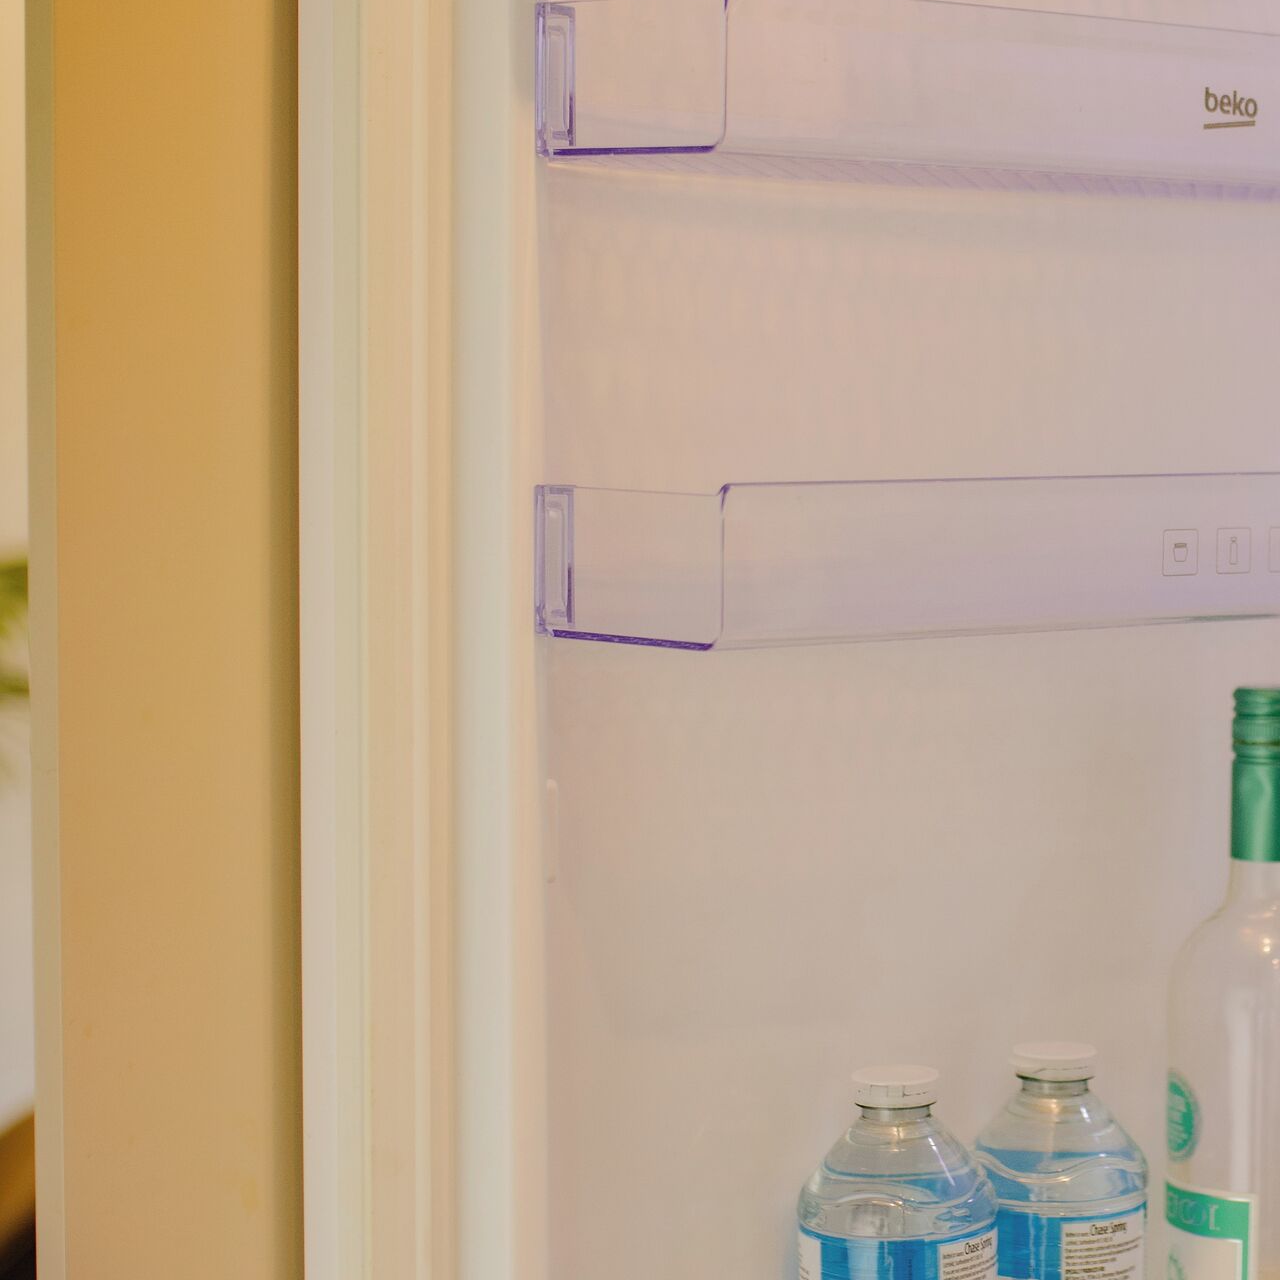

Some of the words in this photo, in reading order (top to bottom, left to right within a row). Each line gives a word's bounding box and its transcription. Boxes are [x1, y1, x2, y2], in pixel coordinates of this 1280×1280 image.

[1204, 87, 1258, 118] beko
[1090, 1224, 1108, 1236] Chase
[964, 1242, 980, 1255] Chase
